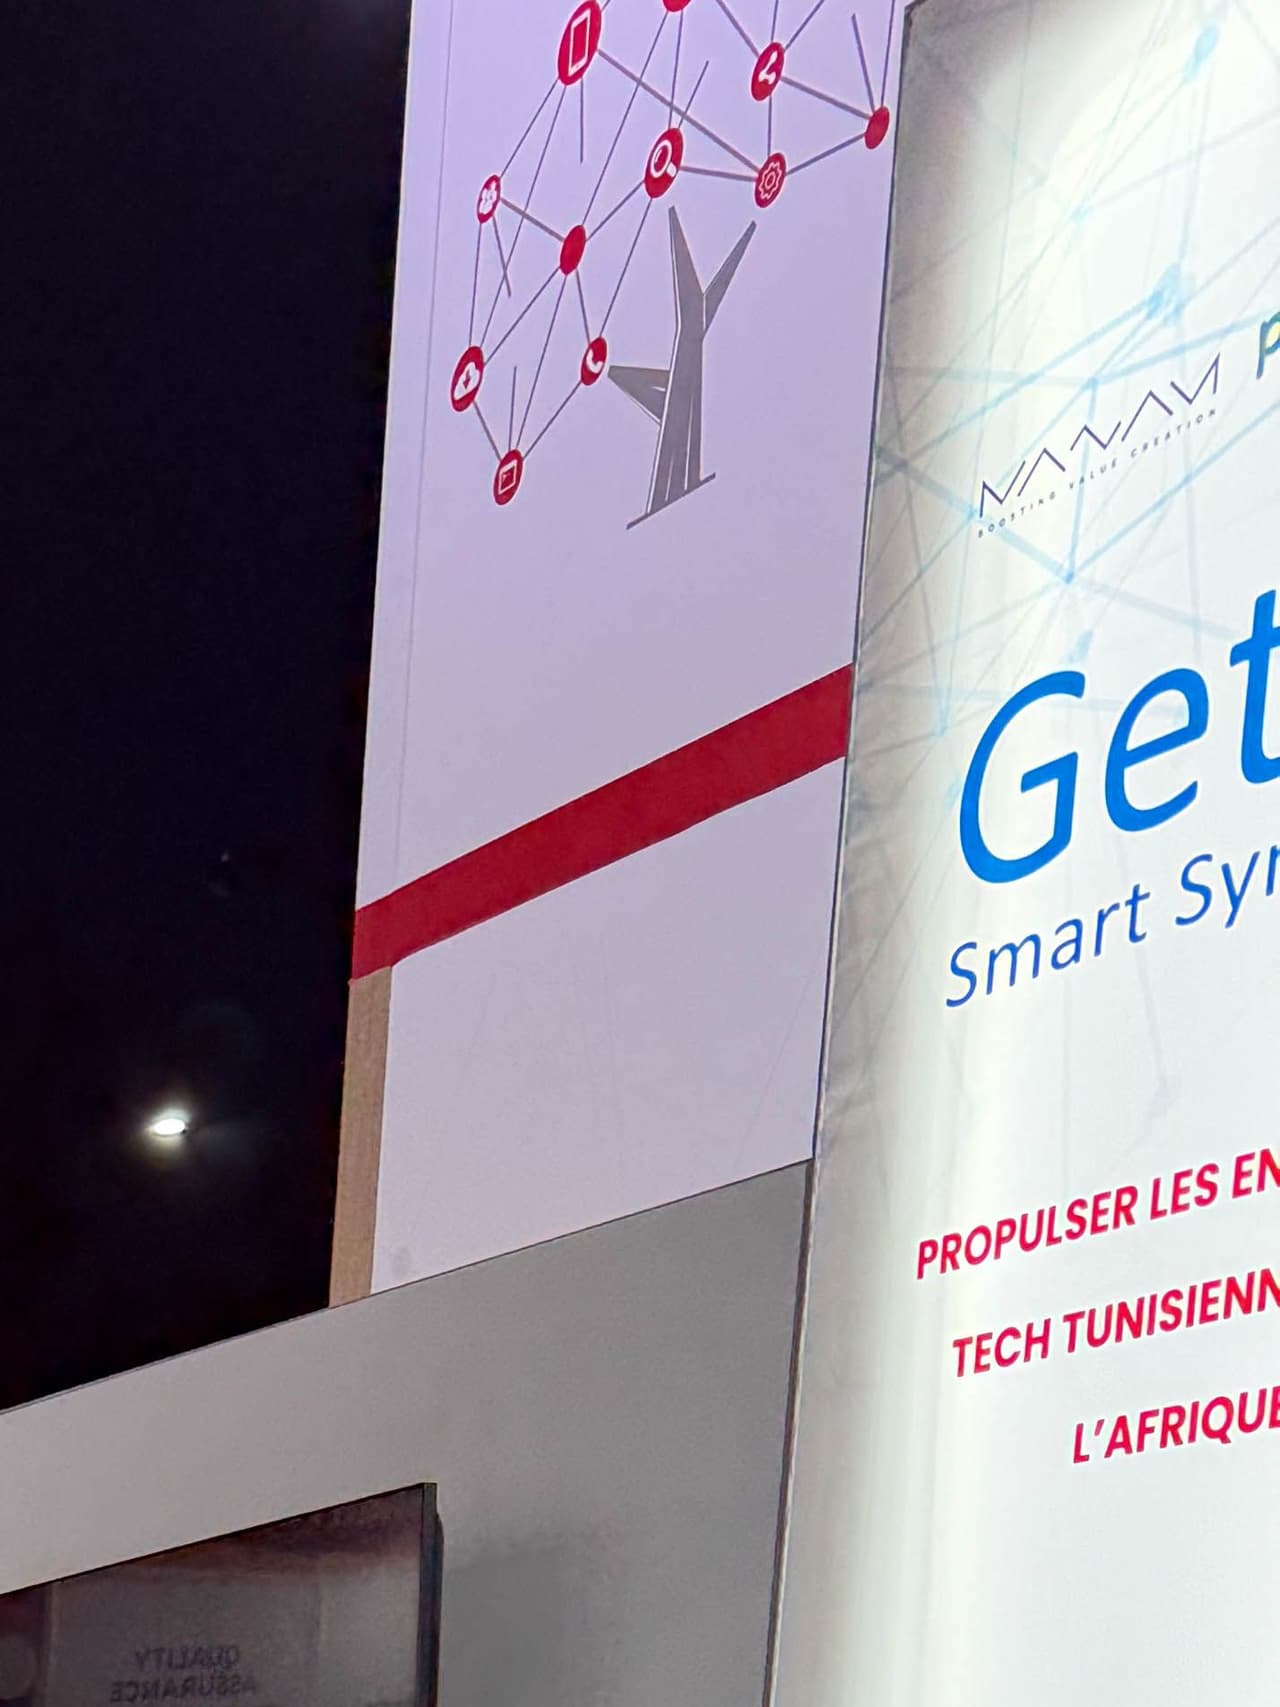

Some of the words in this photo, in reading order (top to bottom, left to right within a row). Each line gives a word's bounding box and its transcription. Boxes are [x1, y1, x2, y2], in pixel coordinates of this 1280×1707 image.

[978, 491, 1056, 538] BOOSTING
[1069, 458, 1118, 489] VALUE
[1130, 408, 1217, 458] CREATION
[959, 589, 1280, 884] Get
[946, 884, 1151, 1008] Smart
[916, 1185, 1139, 1281] PROPULSER
[1150, 1163, 1220, 1221] LES
[952, 1317, 1052, 1378] TECH
